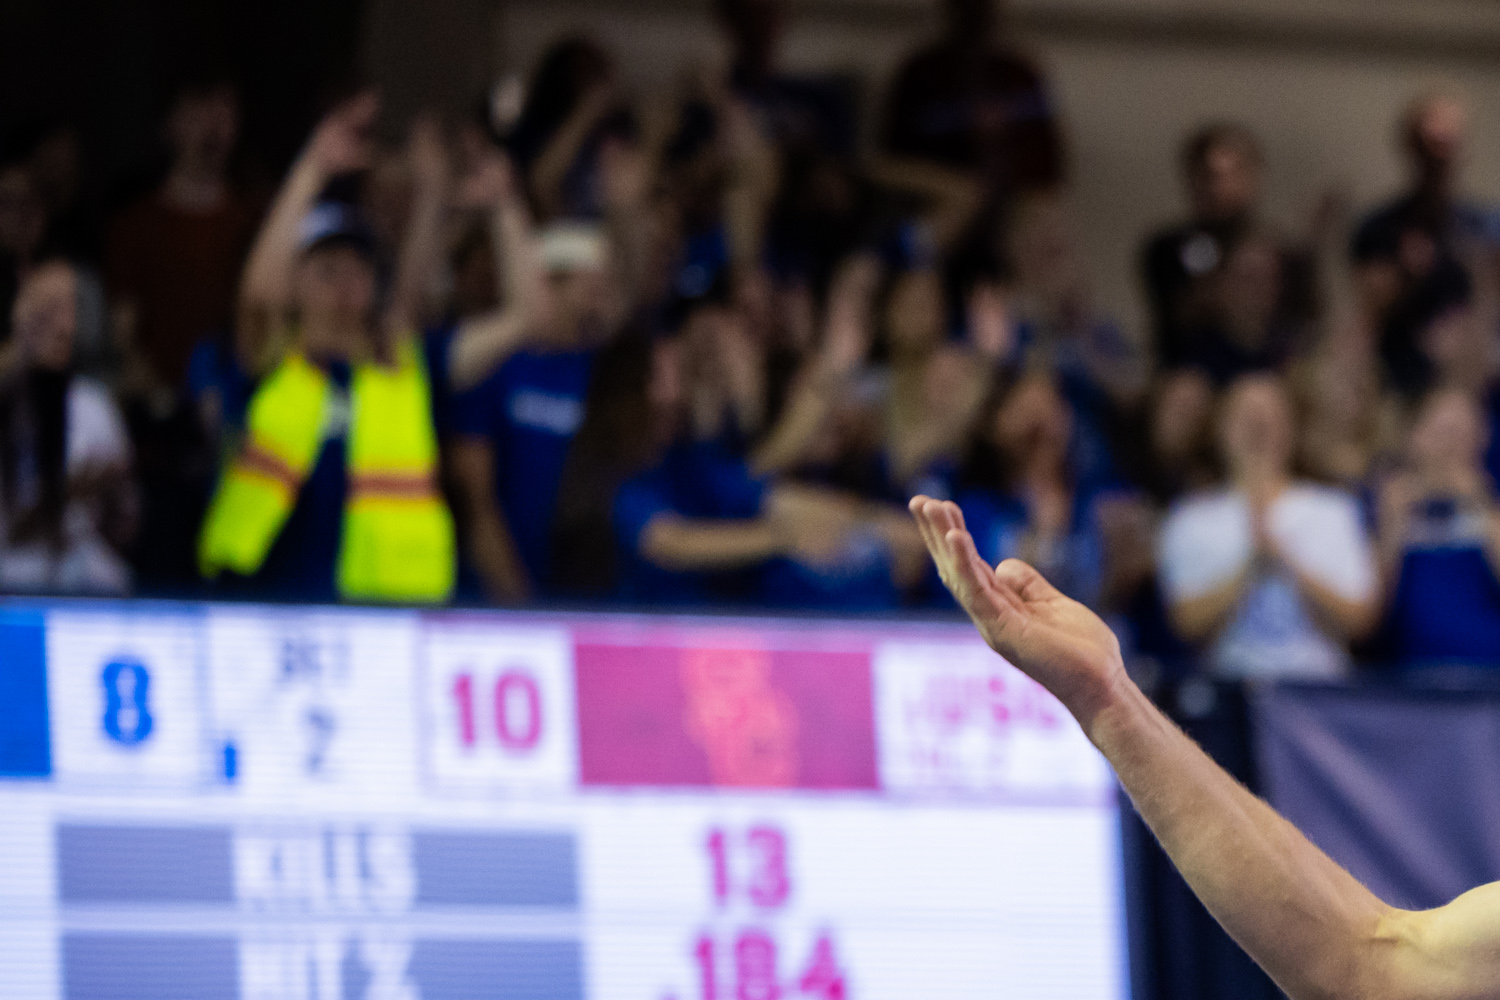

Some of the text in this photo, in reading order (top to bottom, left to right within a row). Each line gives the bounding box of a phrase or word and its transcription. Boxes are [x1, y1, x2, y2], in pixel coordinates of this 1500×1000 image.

[100, 660, 154, 747] 8
[452, 670, 544, 753] 10
[706, 824, 792, 908] 13
